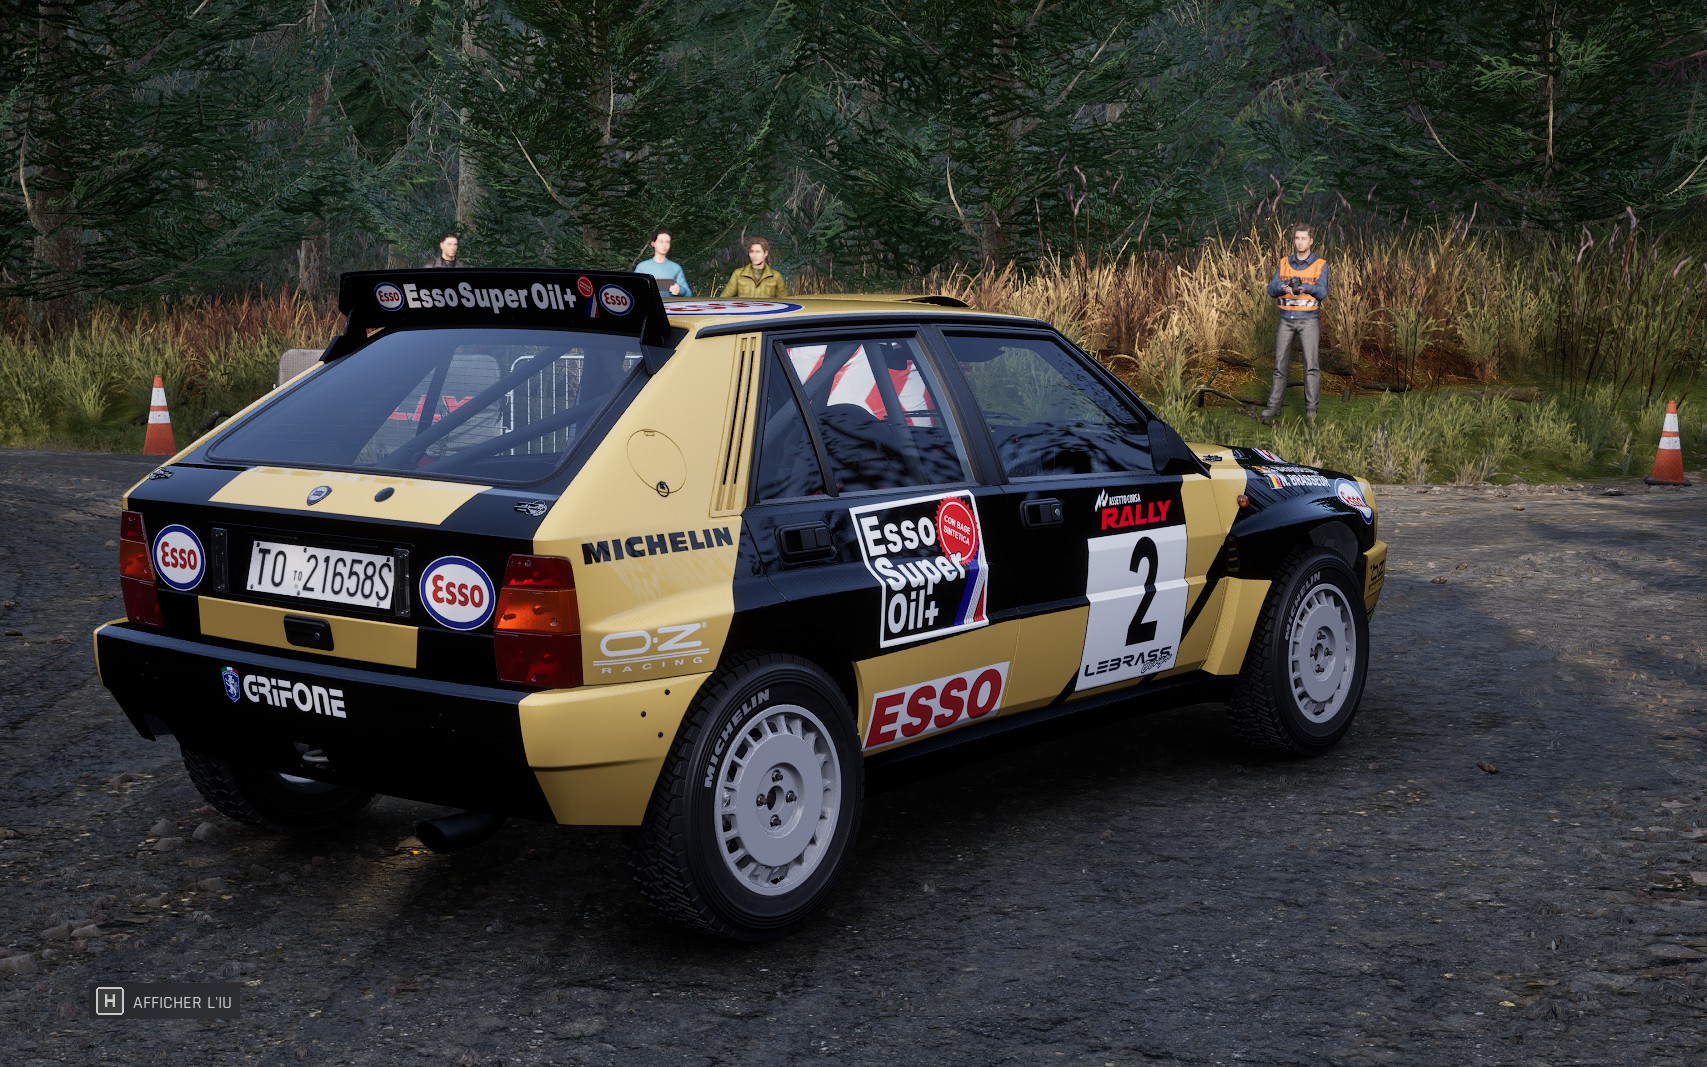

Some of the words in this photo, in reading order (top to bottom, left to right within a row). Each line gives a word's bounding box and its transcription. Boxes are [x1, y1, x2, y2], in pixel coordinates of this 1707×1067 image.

[378, 290, 400, 302] Esso
[403, 283, 458, 308] Esso
[458, 281, 527, 314] Super
[531, 282, 577, 310] Oil+
[604, 292, 628, 306] Esso
[943, 515, 956, 527] CON
[957, 520, 971, 535] BASE
[1101, 500, 1171, 530] RALLY
[581, 527, 734, 565] MICHELIN
[860, 515, 936, 557] Esso
[943, 525, 970, 546] SINTETICA
[161, 541, 197, 570] Esso
[258, 548, 287, 587] TO
[432, 574, 484, 608] Esso
[874, 552, 966, 596] Super
[1125, 536, 1159, 647] 2
[887, 589, 940, 634] Oil+
[601, 657, 703, 674] RACING
[1084, 646, 1172, 677] LEBRASS
[243, 674, 347, 719] GRIFONE
[865, 668, 1002, 748] ESSO
[703, 687, 770, 788] MICHELIN
